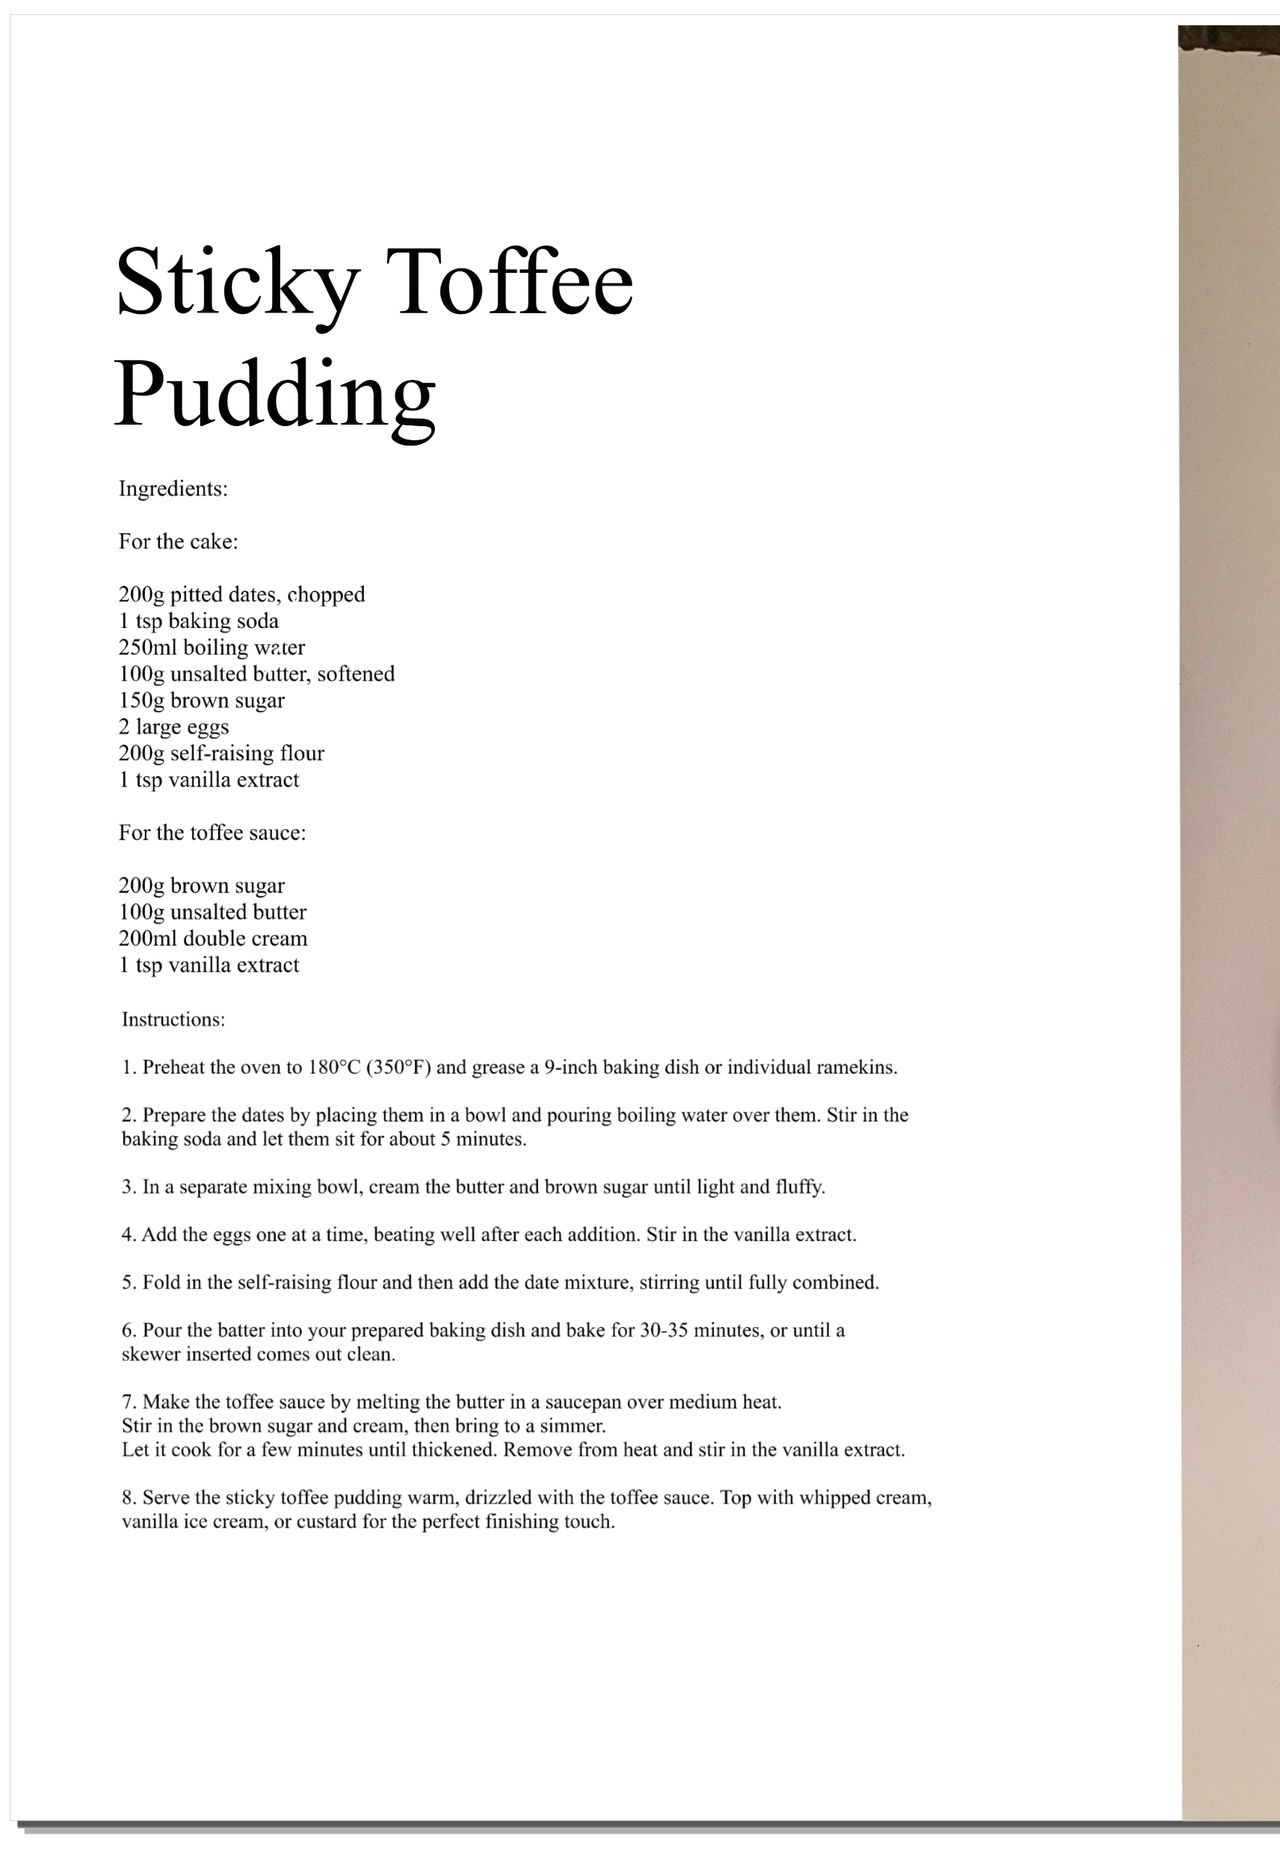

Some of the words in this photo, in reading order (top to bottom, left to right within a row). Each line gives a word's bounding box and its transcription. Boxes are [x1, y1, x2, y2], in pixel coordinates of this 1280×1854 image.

[118, 244, 362, 335] Sticky
[386, 244, 633, 316] Toffee
[113, 356, 437, 447] Pudding
[119, 479, 228, 502] Ingredients:
[118, 532, 152, 550] For
[156, 532, 185, 550] the
[190, 532, 238, 550] cake:
[118, 585, 165, 608] 200g
[170, 584, 223, 608] pitted
[228, 584, 282, 606] dates,
[287, 584, 366, 608] chopped
[121, 612, 128, 629] 1
[135, 614, 163, 634] tsp
[168, 611, 232, 634] baking
[237, 611, 280, 630] soda
[118, 637, 177, 656] 250ml
[183, 637, 249, 661] boiling
[254, 642, 306, 656] water
[121, 664, 165, 687] 100g
[170, 664, 247, 682] unsalted
[252, 664, 312, 685] butter,
[317, 664, 395, 682] softened
[121, 691, 165, 713] 150g
[170, 690, 229, 709] brown
[235, 696, 286, 714] sugar
[118, 717, 130, 735] 2
[136, 717, 182, 740] large
[187, 722, 230, 740] eggs
[118, 743, 165, 766] 200g
[170, 743, 274, 766] self-raising
[280, 743, 326, 762] flour
[121, 770, 128, 788] 1
[135, 772, 163, 793] tsp
[168, 770, 232, 788] vanilla
[237, 773, 300, 788] extract
[118, 823, 152, 841] For
[156, 823, 185, 841] the
[190, 822, 244, 841] toffee
[249, 828, 306, 841] sauce:
[118, 876, 165, 899] 200g
[170, 876, 230, 894] brown
[235, 881, 286, 899] sugar
[121, 902, 165, 925] 100g
[170, 902, 248, 921] unsalted
[252, 902, 308, 921] butter
[118, 929, 177, 947] 200ml
[183, 928, 246, 947] double
[251, 934, 308, 947] cream
[121, 956, 128, 973] 1
[136, 957, 163, 978] tsp
[168, 955, 232, 973] vanilla
[237, 958, 300, 974] extract
[122, 1010, 225, 1027] Instructions:
[124, 1059, 137, 1075] 1.
[143, 1058, 205, 1075] Preheat
[210, 1058, 236, 1075] the
[240, 1063, 281, 1075] oven
[286, 1061, 303, 1075] to
[310, 1058, 361, 1075] 180°C
[366, 1059, 432, 1078] (350°F)
[436, 1058, 467, 1075] and
[471, 1063, 526, 1079] grease
[530, 1063, 540, 1075] a
[544, 1058, 598, 1075] 9-inch
[602, 1058, 660, 1079] baking
[664, 1058, 700, 1075] dish
[704, 1063, 723, 1075] or
[728, 1058, 812, 1075] individual
[816, 1058, 898, 1075] ramekins.
[121, 1130, 179, 1151] baking
[183, 1130, 222, 1147] soda
[226, 1130, 257, 1147] and
[262, 1130, 284, 1147] let
[287, 1130, 330, 1147] them
[335, 1130, 356, 1147] sit
[359, 1130, 385, 1147] for
[389, 1130, 436, 1147] about
[440, 1130, 451, 1147] 5
[456, 1130, 527, 1147] minutes.
[121, 1178, 137, 1195] 3.
[143, 1178, 160, 1195] In
[165, 1183, 175, 1194] a
[179, 1181, 248, 1199] separate
[253, 1178, 312, 1199] mixing
[317, 1178, 364, 1197] bowl,
[369, 1182, 420, 1195] cream
[425, 1178, 451, 1195] the
[455, 1178, 505, 1195] butter
[509, 1178, 540, 1195] and
[544, 1178, 598, 1195] brown
[603, 1183, 649, 1199] sugar
[653, 1178, 691, 1195] until
[697, 1178, 735, 1199] light
[740, 1178, 771, 1195] and
[775, 1178, 826, 1199] fluffy.
[122, 1274, 137, 1290] 5.
[143, 1273, 181, 1290] Fold
[186, 1273, 203, 1290] in
[207, 1273, 233, 1290] the
[238, 1273, 332, 1294] self-raising
[337, 1273, 378, 1290] flour
[382, 1273, 413, 1290] and
[417, 1273, 454, 1290] then
[458, 1273, 489, 1290] add
[493, 1273, 520, 1290] the
[524, 1273, 560, 1290] date
[564, 1273, 634, 1293] mixture,
[639, 1273, 700, 1295] stirring
[705, 1273, 743, 1290] until
[749, 1273, 788, 1294] fully
[792, 1273, 879, 1290] combined.
[122, 1345, 182, 1362] skewer
[186, 1345, 252, 1362] inserted
[256, 1350, 310, 1362] comes
[315, 1348, 342, 1362] out
[347, 1345, 396, 1362] clean.
[122, 1441, 150, 1458] Let
[155, 1441, 166, 1457] it
[171, 1441, 212, 1457] cook
[218, 1440, 243, 1457] for
[246, 1445, 256, 1457] a
[262, 1440, 292, 1458] few
[297, 1440, 364, 1458] minutes
[368, 1441, 406, 1458] until
[412, 1440, 498, 1458] thickened.
[503, 1441, 573, 1458] Remove
[578, 1440, 618, 1457] from
[623, 1441, 658, 1457] heat
[663, 1441, 694, 1458] and
[698, 1441, 726, 1457] stir
[731, 1441, 746, 1457] in
[751, 1441, 777, 1458] the
[782, 1441, 839, 1457] vanilla
[844, 1443, 905, 1458] extract.
[122, 1489, 137, 1505] 8.
[143, 1489, 190, 1506] Serve
[195, 1488, 221, 1505] the
[225, 1488, 276, 1509] sticky
[281, 1488, 329, 1505] toffee
[334, 1488, 403, 1510] pudding
[407, 1493, 460, 1507] warm,
[465, 1488, 532, 1505] drizzled
[537, 1488, 575, 1505] with
[579, 1488, 605, 1505] the
[610, 1488, 659, 1505] toffee
[663, 1493, 714, 1505] sauce.
[719, 1489, 752, 1510] Top
[757, 1488, 794, 1505] with
[799, 1488, 871, 1510] whipped
[876, 1493, 932, 1508] cream,
